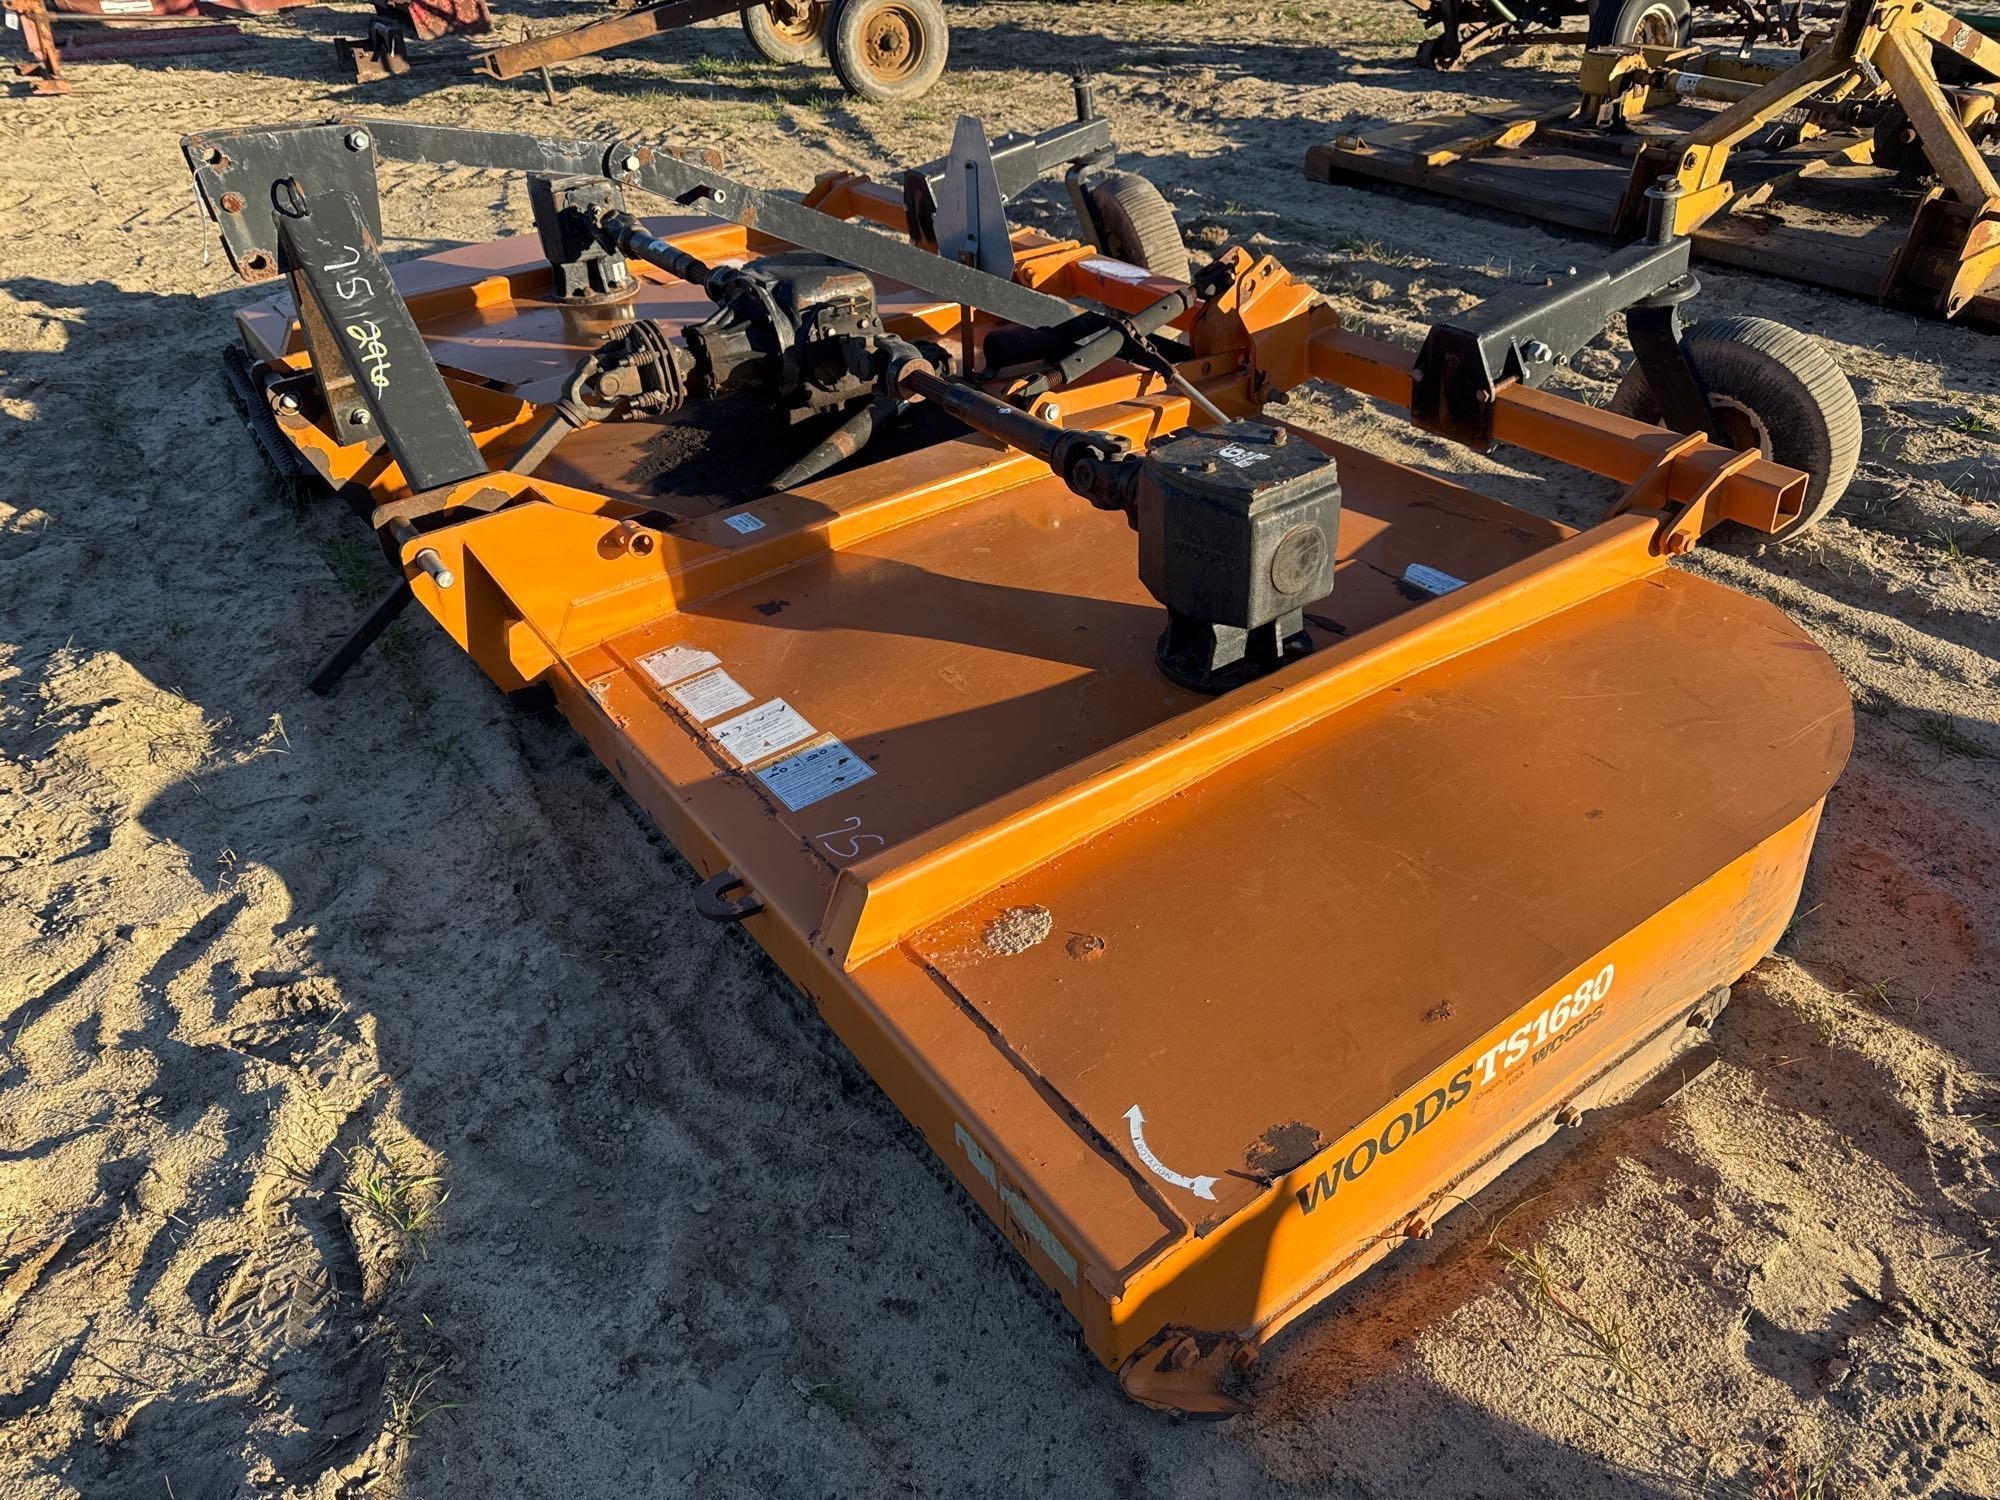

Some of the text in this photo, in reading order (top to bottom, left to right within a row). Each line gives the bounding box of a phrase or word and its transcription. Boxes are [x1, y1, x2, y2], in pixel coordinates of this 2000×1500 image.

[324, 245, 375, 299] 75
[682, 671, 718, 688] WARNING
[779, 742, 816, 761] WARNING
[815, 816, 885, 858] 75
[1295, 963, 1615, 1217] WOODS TS1680
[1136, 1142, 1174, 1180] ROTATION
